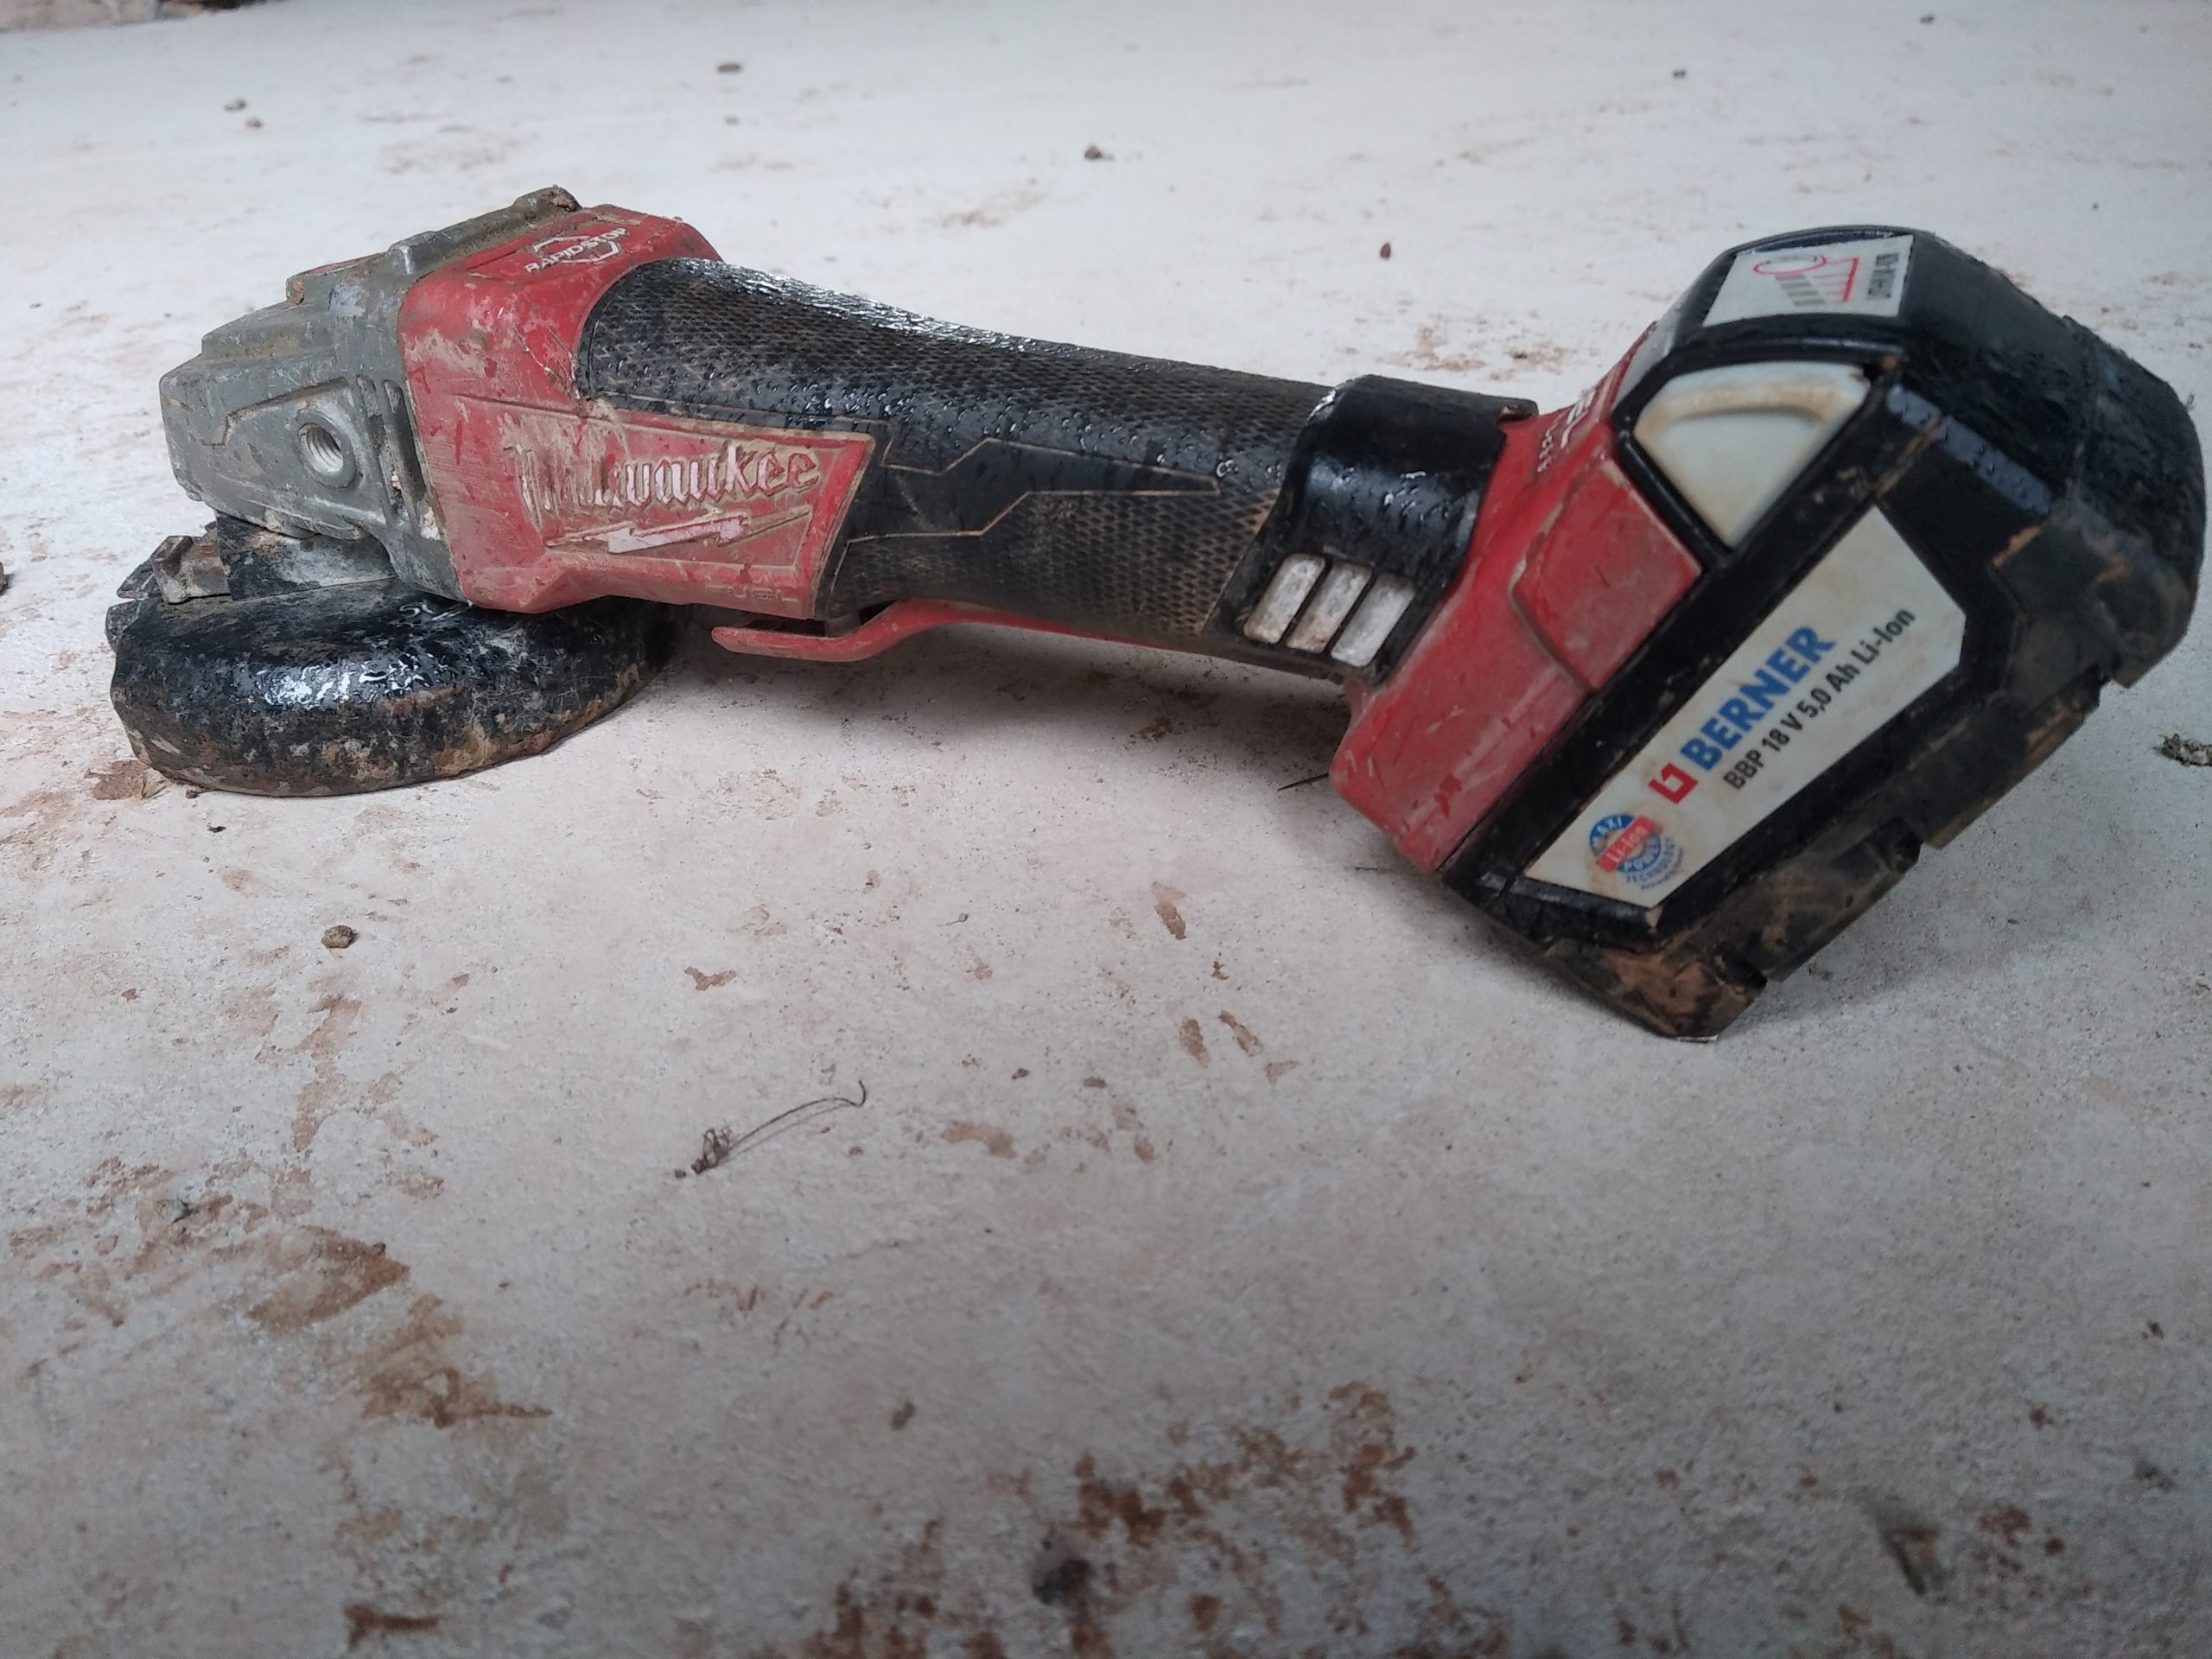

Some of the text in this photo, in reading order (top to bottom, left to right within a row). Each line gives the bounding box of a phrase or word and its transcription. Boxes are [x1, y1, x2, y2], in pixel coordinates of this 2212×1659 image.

[506, 442, 819, 527] waukee
[1679, 625, 1837, 772] BERNER
[1723, 608, 1916, 790] BBP 18 V 5,0 Ah Li-Ion
